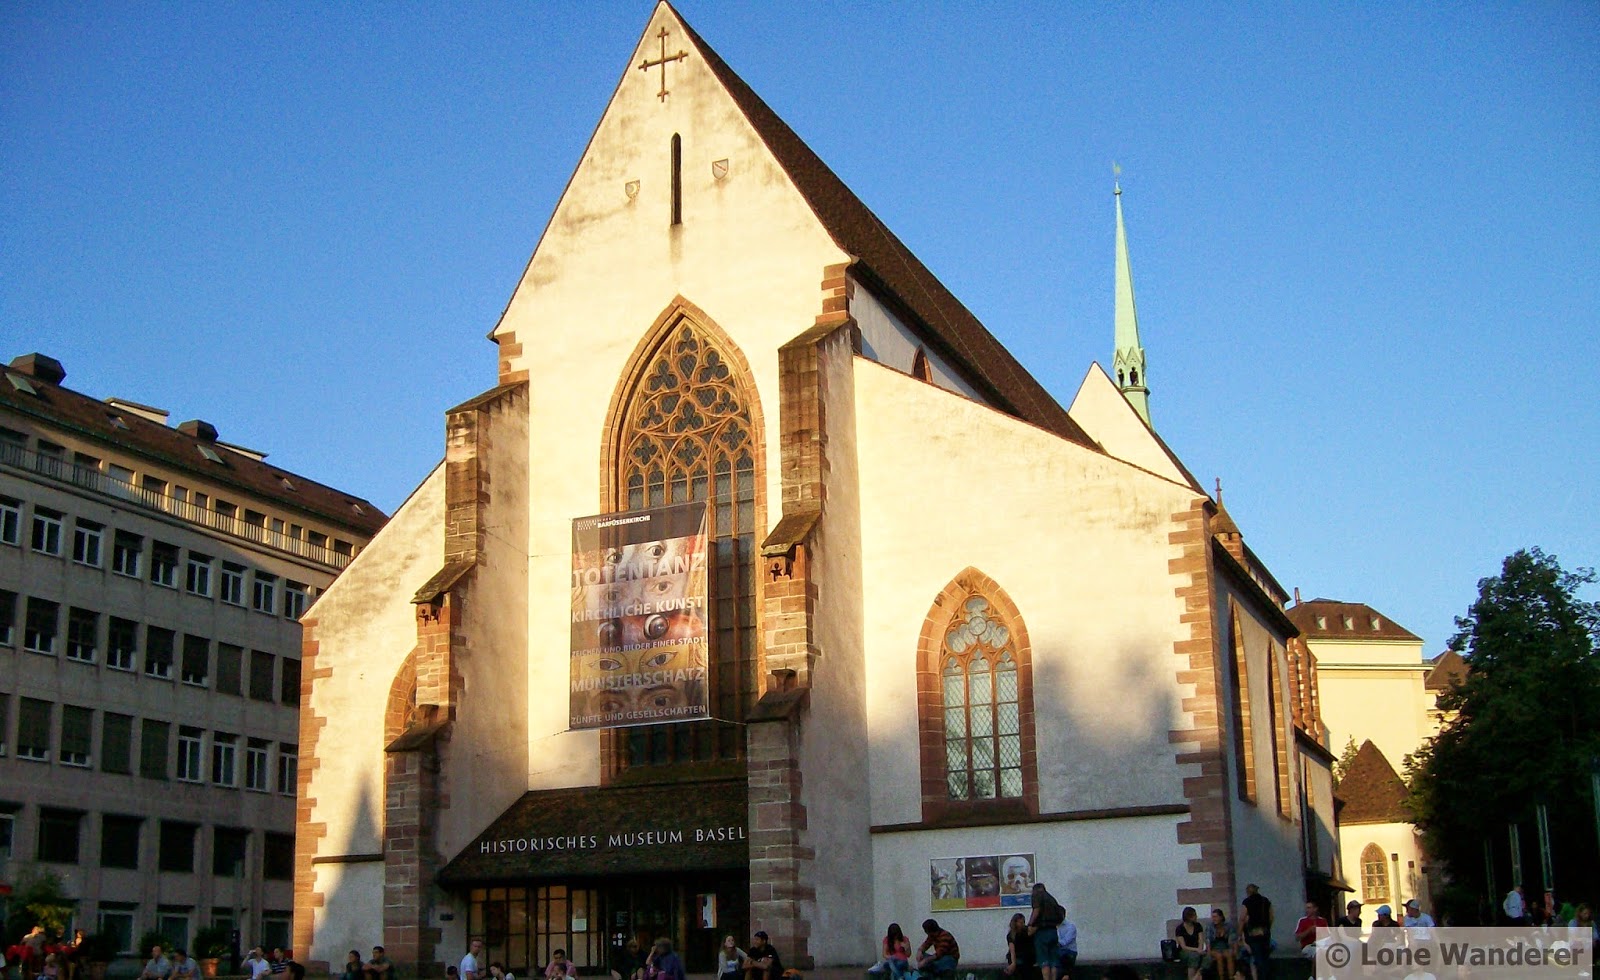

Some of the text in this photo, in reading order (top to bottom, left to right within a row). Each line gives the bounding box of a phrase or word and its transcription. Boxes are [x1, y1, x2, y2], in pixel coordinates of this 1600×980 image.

[597, 515, 651, 528] BARFÜSSERKIRCHE
[572, 552, 705, 588] TOTENTANZ
[572, 596, 704, 623] KIRCHLICHE KUNST
[572, 636, 705, 657] ZEICHEN UND BILDER EINER STADT
[571, 667, 705, 692] MÜNSTERSCHATZ
[571, 704, 706, 725] ZÜNFTE UND GESELLSCHAFTEN
[480, 826, 746, 854] HISTORISCHES MUSEUM BASEL
